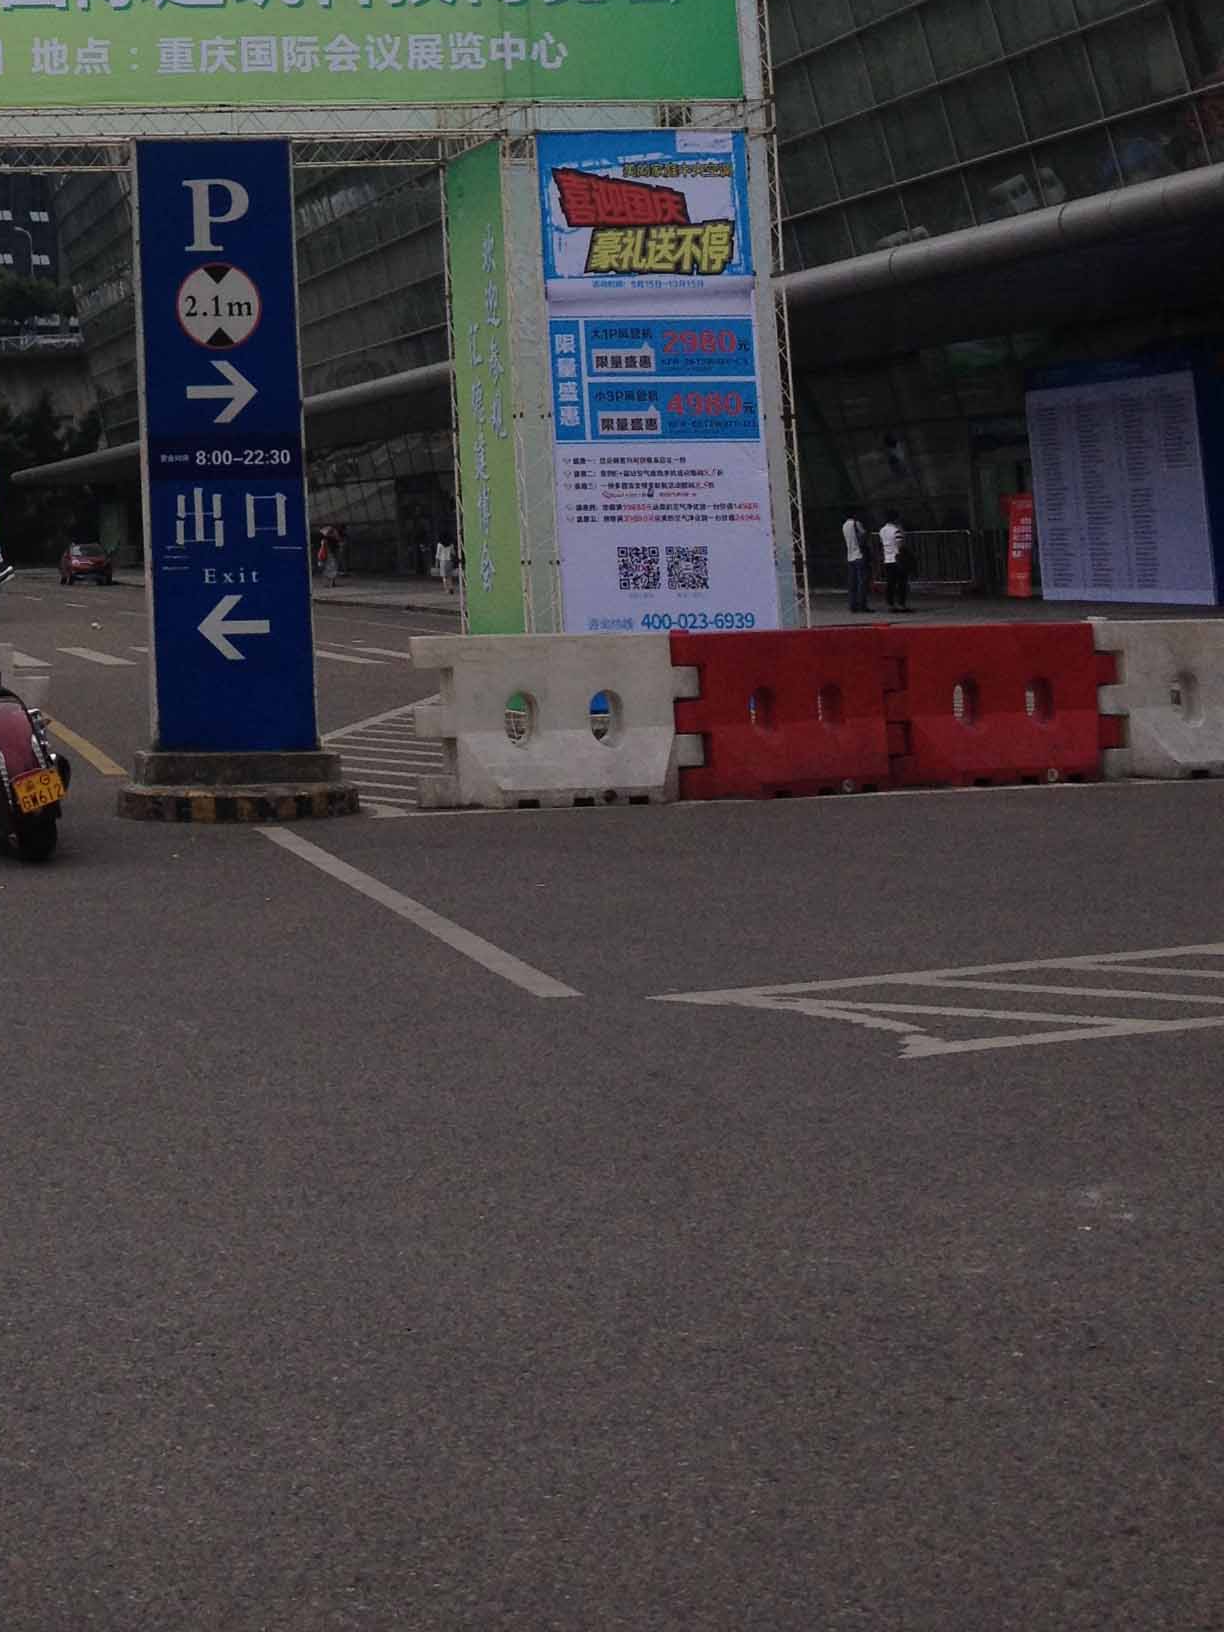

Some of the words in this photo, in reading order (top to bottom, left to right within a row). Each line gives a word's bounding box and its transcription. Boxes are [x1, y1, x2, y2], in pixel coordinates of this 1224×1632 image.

[181, 178, 249, 252] P
[590, 223, 730, 274] 豪礼送不停
[184, 296, 252, 317] 2.1m
[196, 449, 291, 466] 8:00-22:30
[176, 487, 287, 548] 出口
[204, 567, 259, 585] Exit
[641, 612, 756, 630] 400-023-6939
